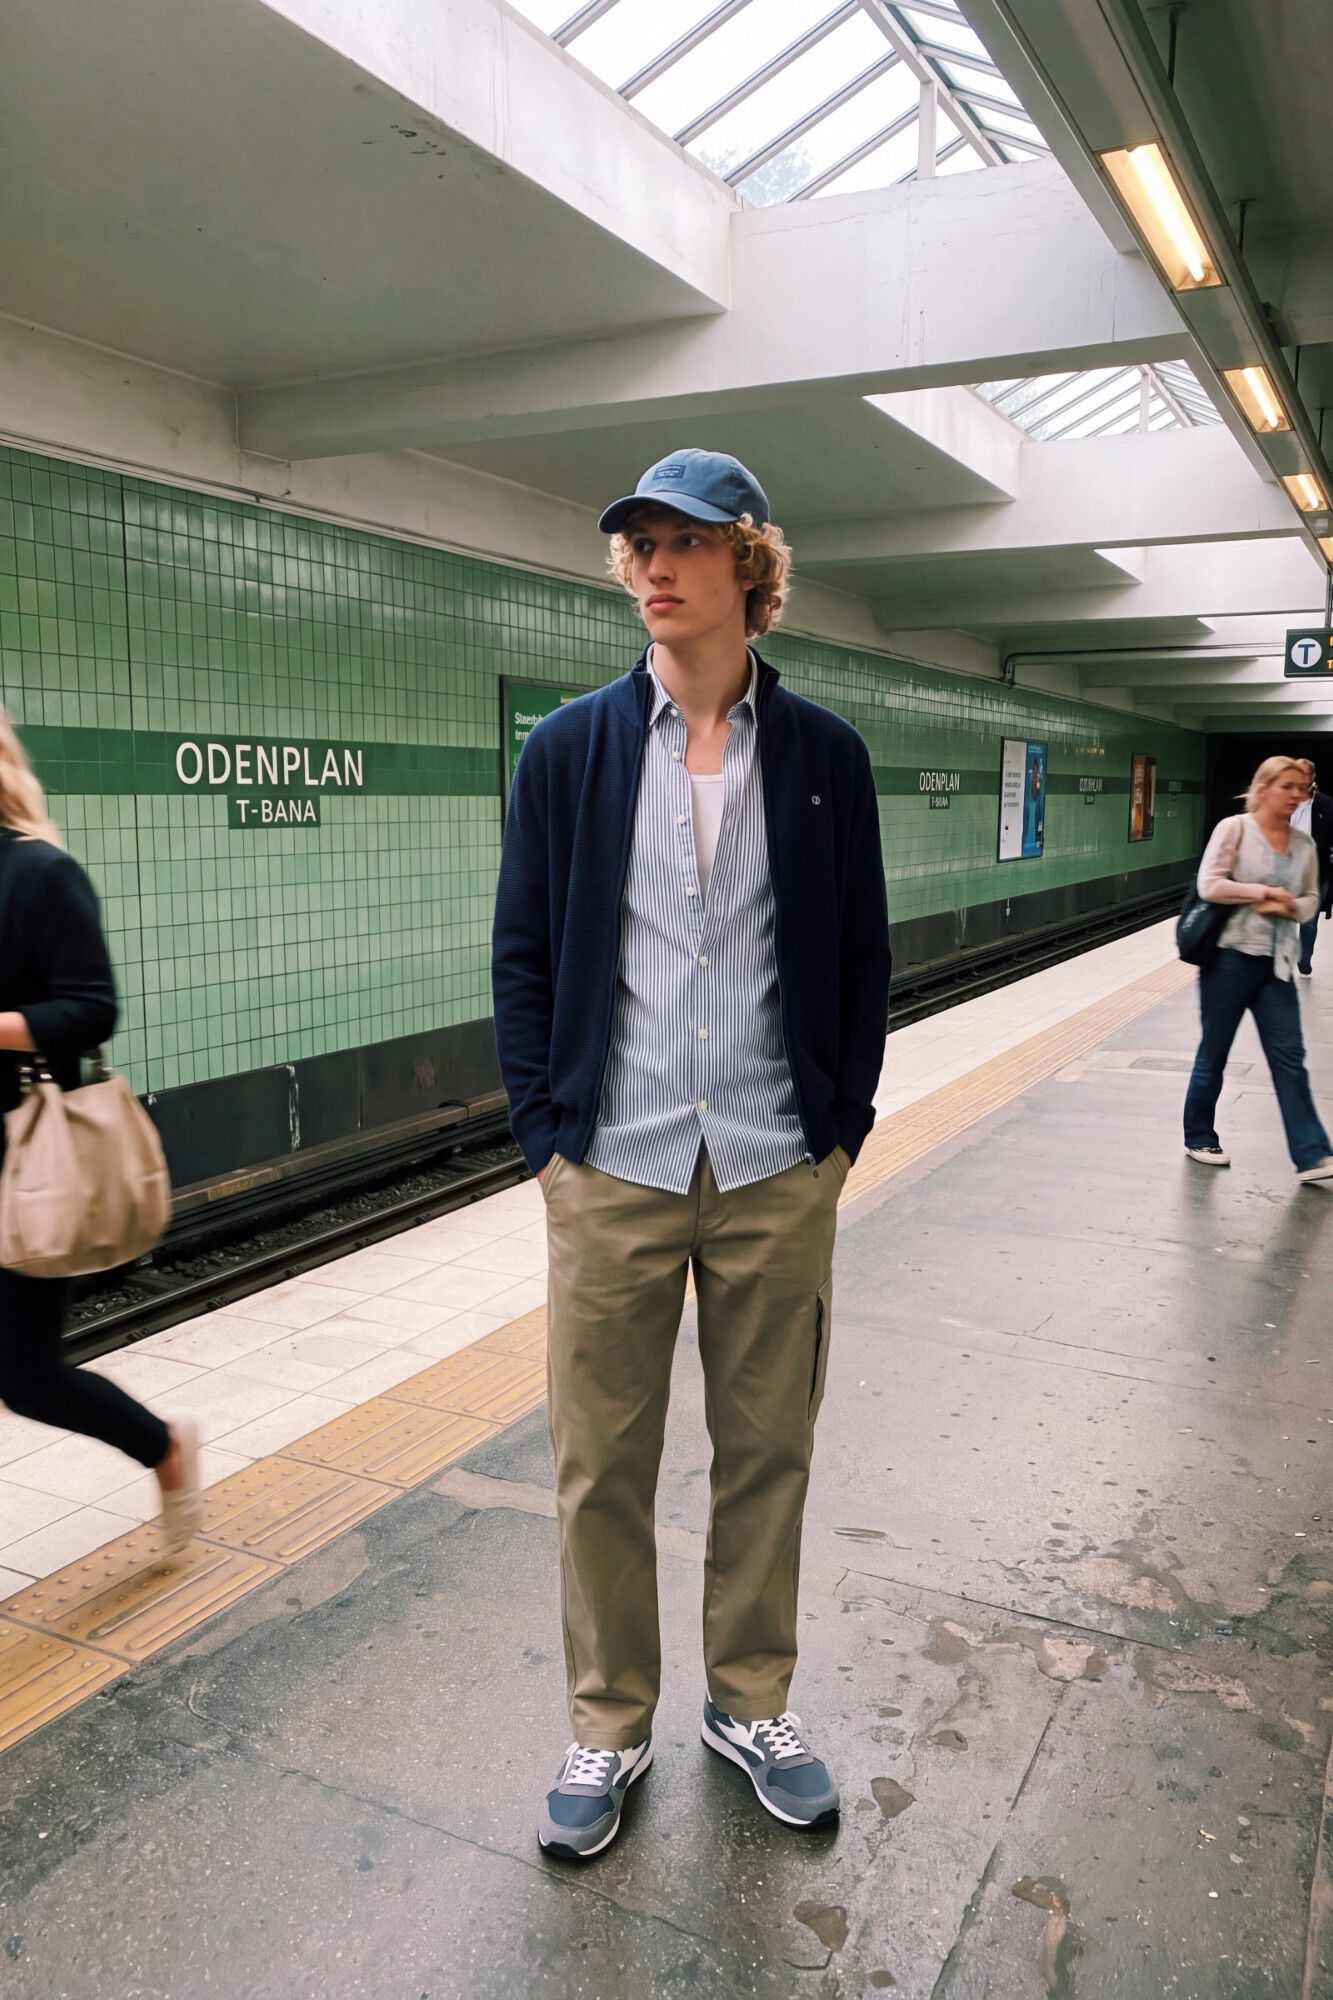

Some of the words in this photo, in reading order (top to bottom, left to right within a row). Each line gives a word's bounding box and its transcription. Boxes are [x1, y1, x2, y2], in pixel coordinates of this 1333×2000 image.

[1297, 643, 1316, 665] T
[175, 741, 364, 787] ODENPLAN
[919, 771, 961, 792] ODENPLAN
[235, 799, 317, 824] T-BANA
